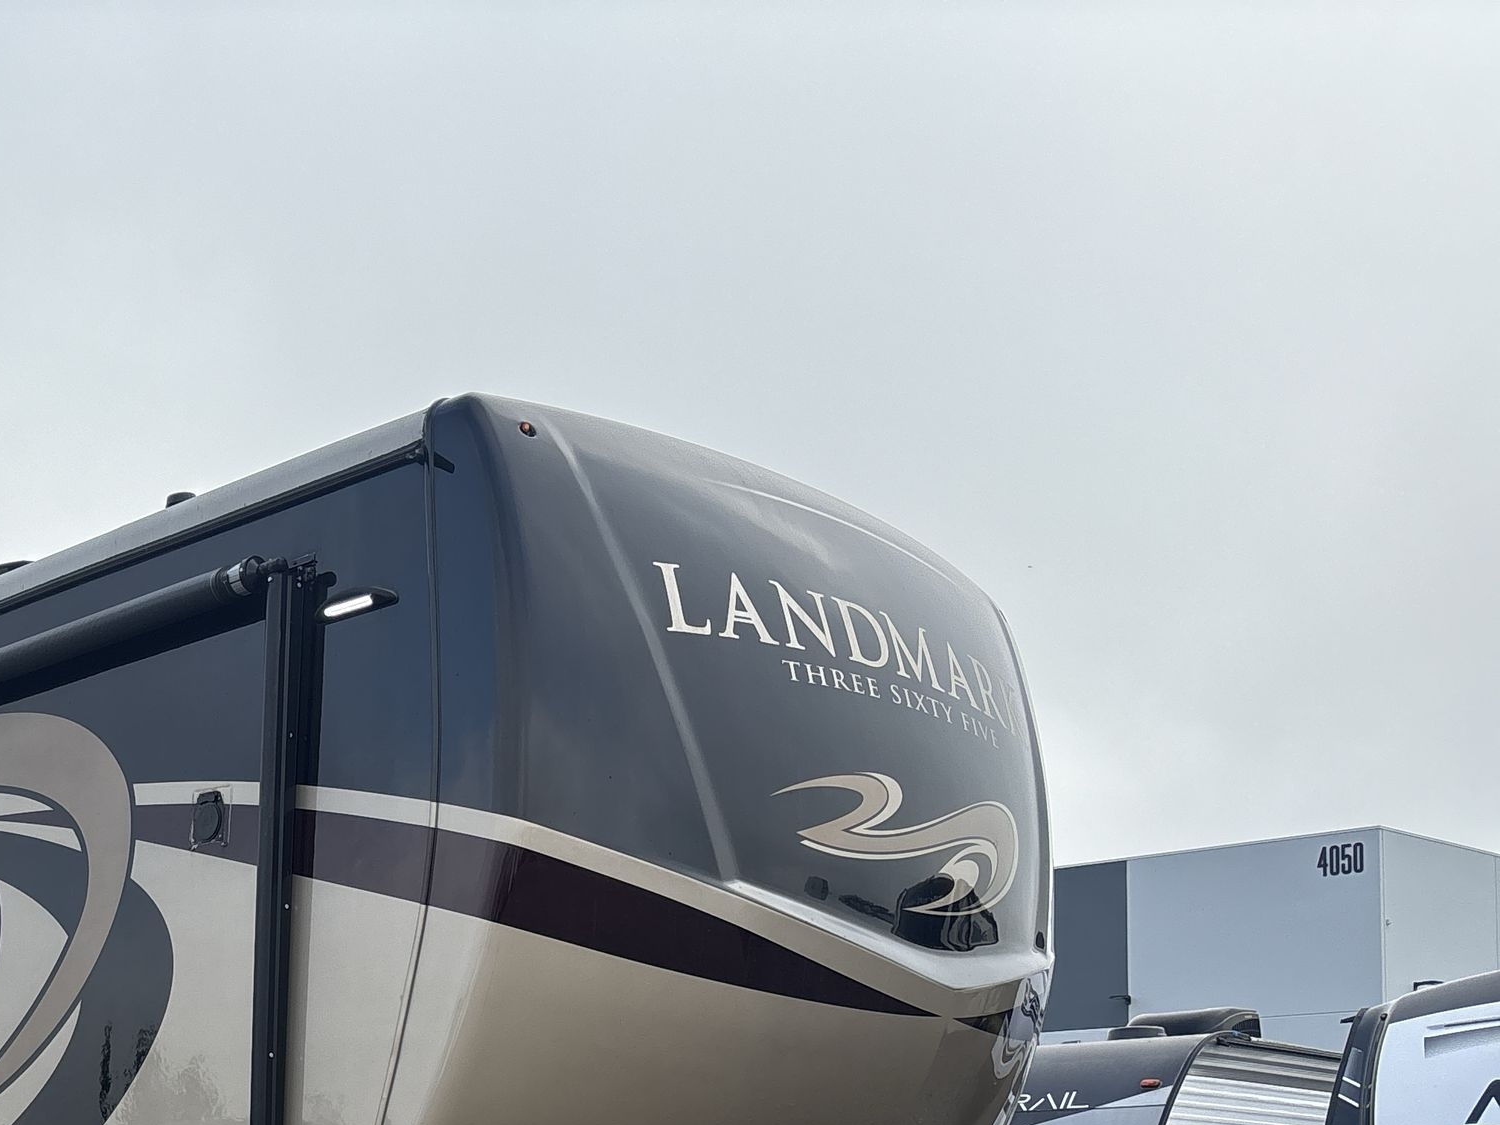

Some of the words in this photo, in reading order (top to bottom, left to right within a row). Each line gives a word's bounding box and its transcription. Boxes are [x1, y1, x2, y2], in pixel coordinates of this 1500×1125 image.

[781, 659, 881, 699] THREE
[889, 684, 953, 724] SIXTY
[960, 711, 1000, 749] FIVE
[1316, 841, 1364, 877] 4050
